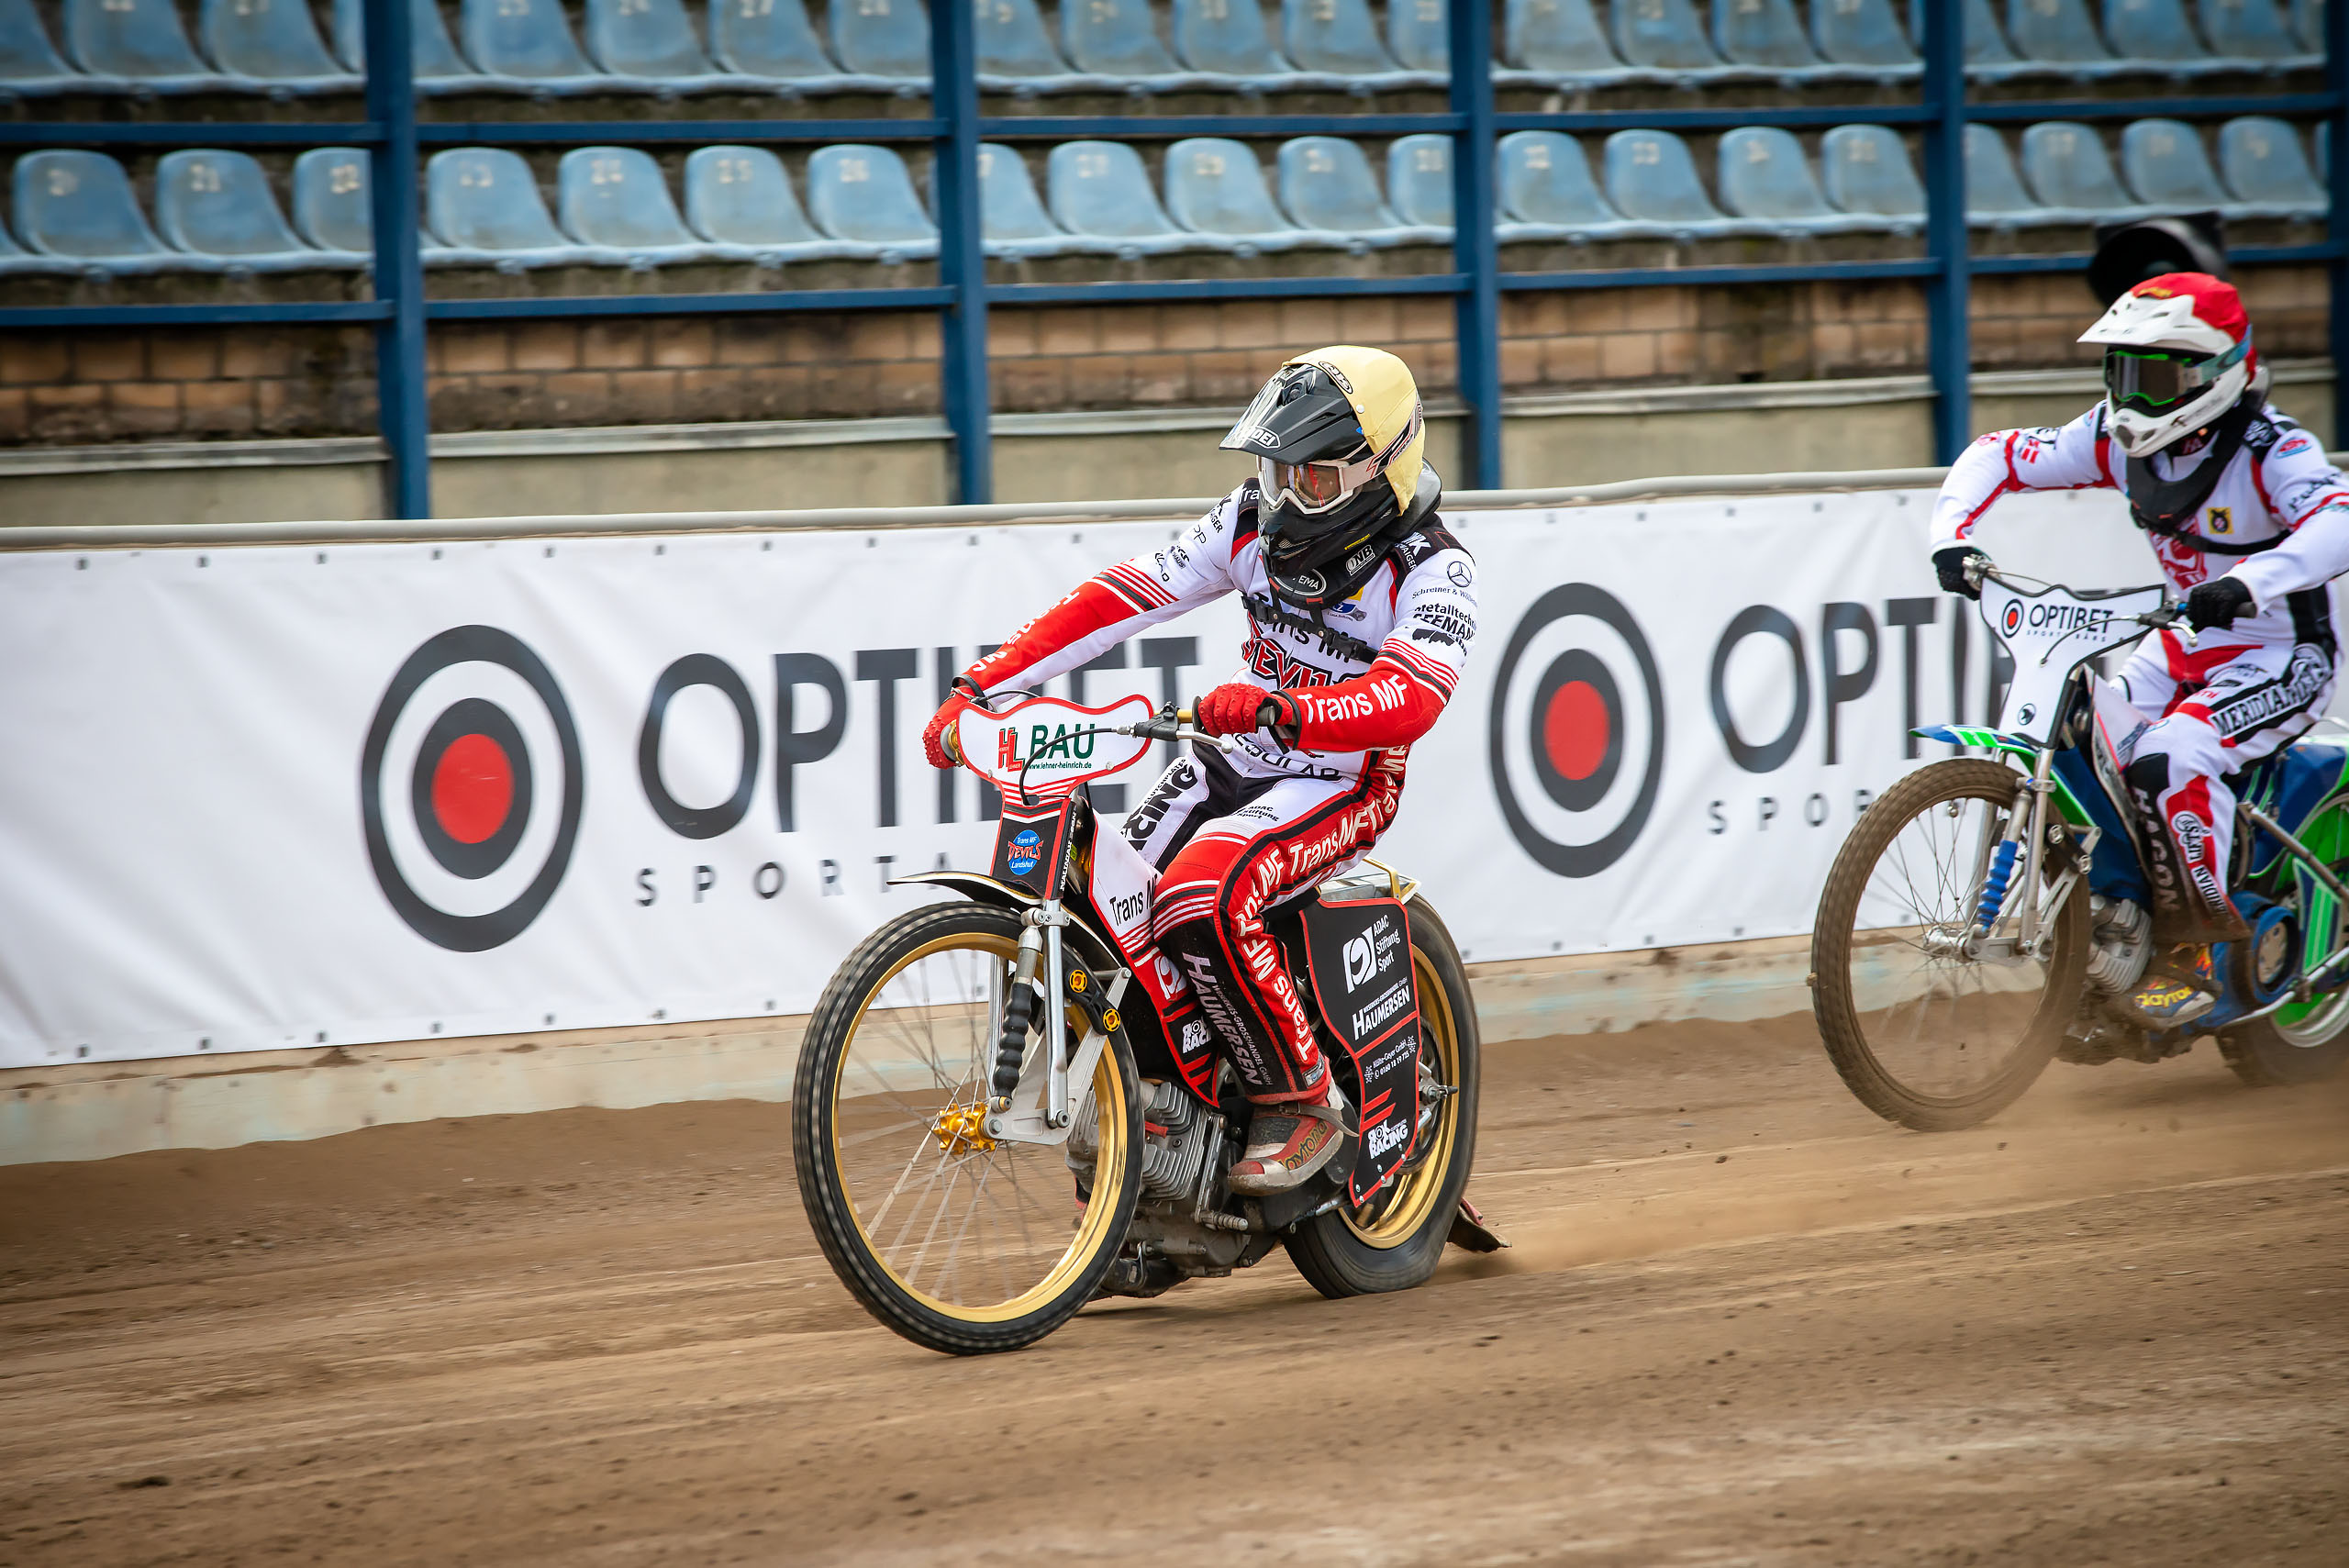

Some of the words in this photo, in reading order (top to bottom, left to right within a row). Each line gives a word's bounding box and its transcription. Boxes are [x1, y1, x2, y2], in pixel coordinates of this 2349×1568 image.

[2026, 629, 2069, 639] SPORT
[2029, 604, 2114, 634] OPTIBET
[1297, 693, 1373, 724] Trans
[1370, 674, 1408, 712] MF
[1030, 723, 1096, 760] BAU
[1008, 840, 1043, 862] DEVILS
[1290, 832, 1338, 876] Trans
[1109, 891, 1144, 927] Trans
[1373, 914, 1389, 937] ADAC
[1375, 929, 1401, 955] Stiftung
[1242, 939, 1276, 982] MF
[1377, 950, 1395, 973] Sport
[1182, 952, 1264, 1084] HAUMERSEN
[1274, 973, 1314, 1062] Trans
[1352, 984, 1411, 1040] HAUMERSEN
[1368, 1124, 1408, 1160] RACING
